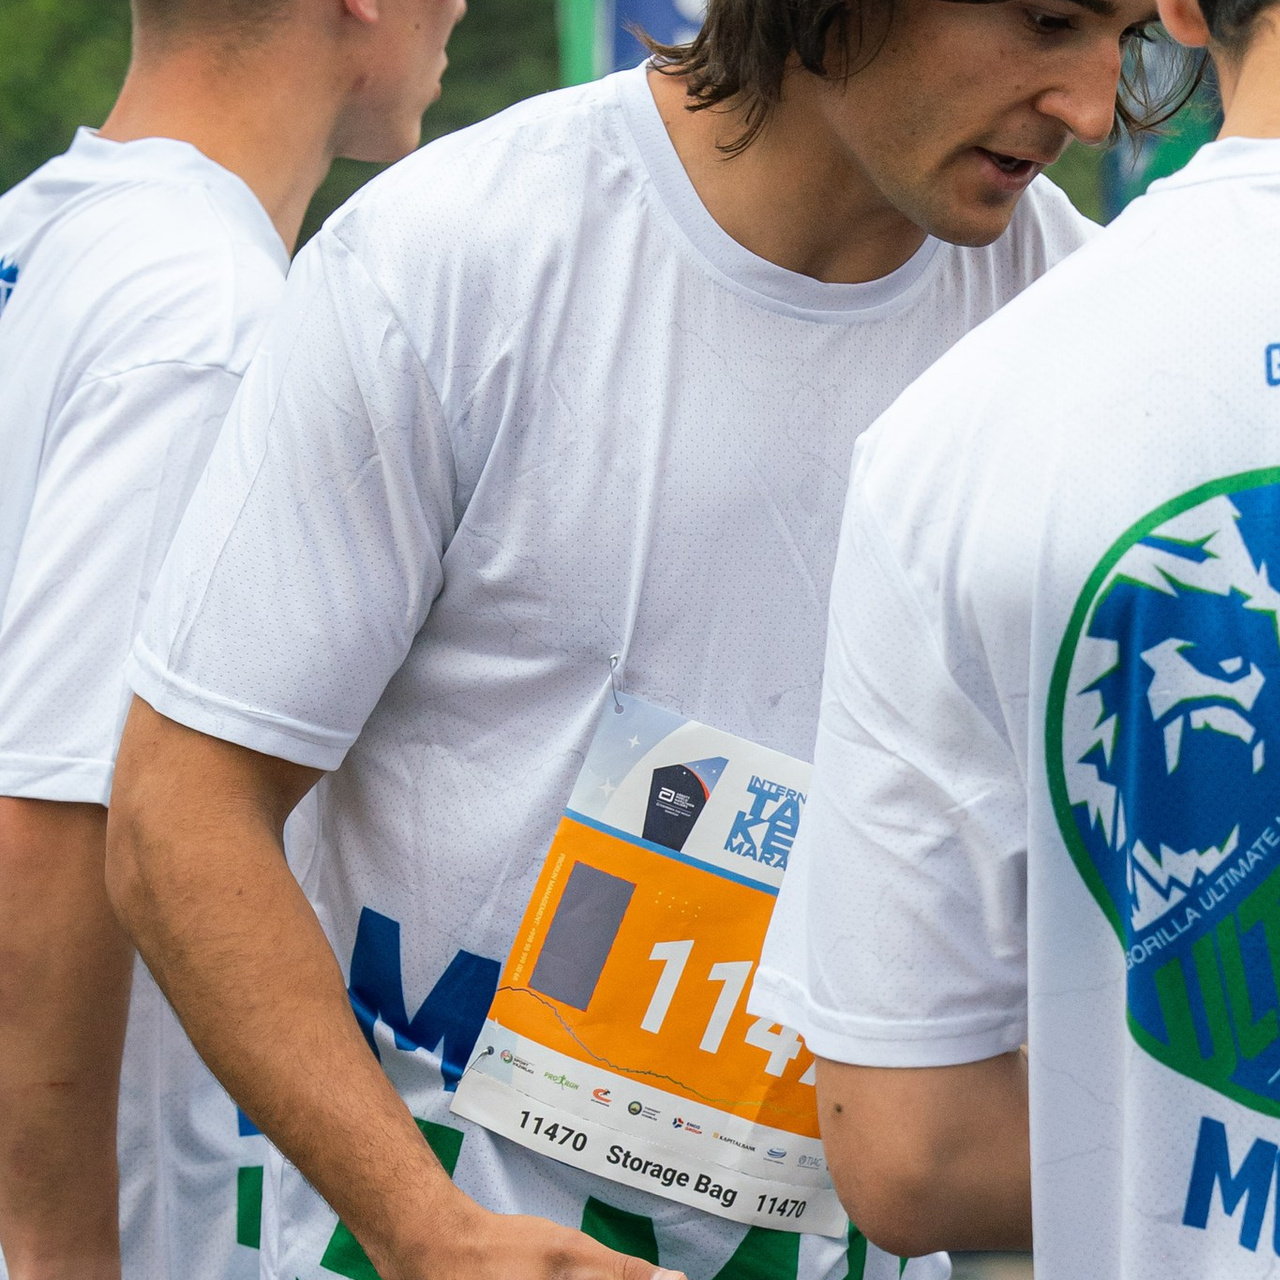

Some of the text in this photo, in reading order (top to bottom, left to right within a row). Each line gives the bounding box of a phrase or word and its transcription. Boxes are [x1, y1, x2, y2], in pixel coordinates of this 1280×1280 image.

[746, 782, 800, 822] TA
[750, 775, 808, 805] INTERN
[731, 810, 800, 853] KE
[723, 837, 789, 872] MARA
[1126, 907, 1202, 970] GORILLA
[639, 939, 817, 1087] 114
[520, 1110, 807, 1219] 11470 Storage Bag 11470
